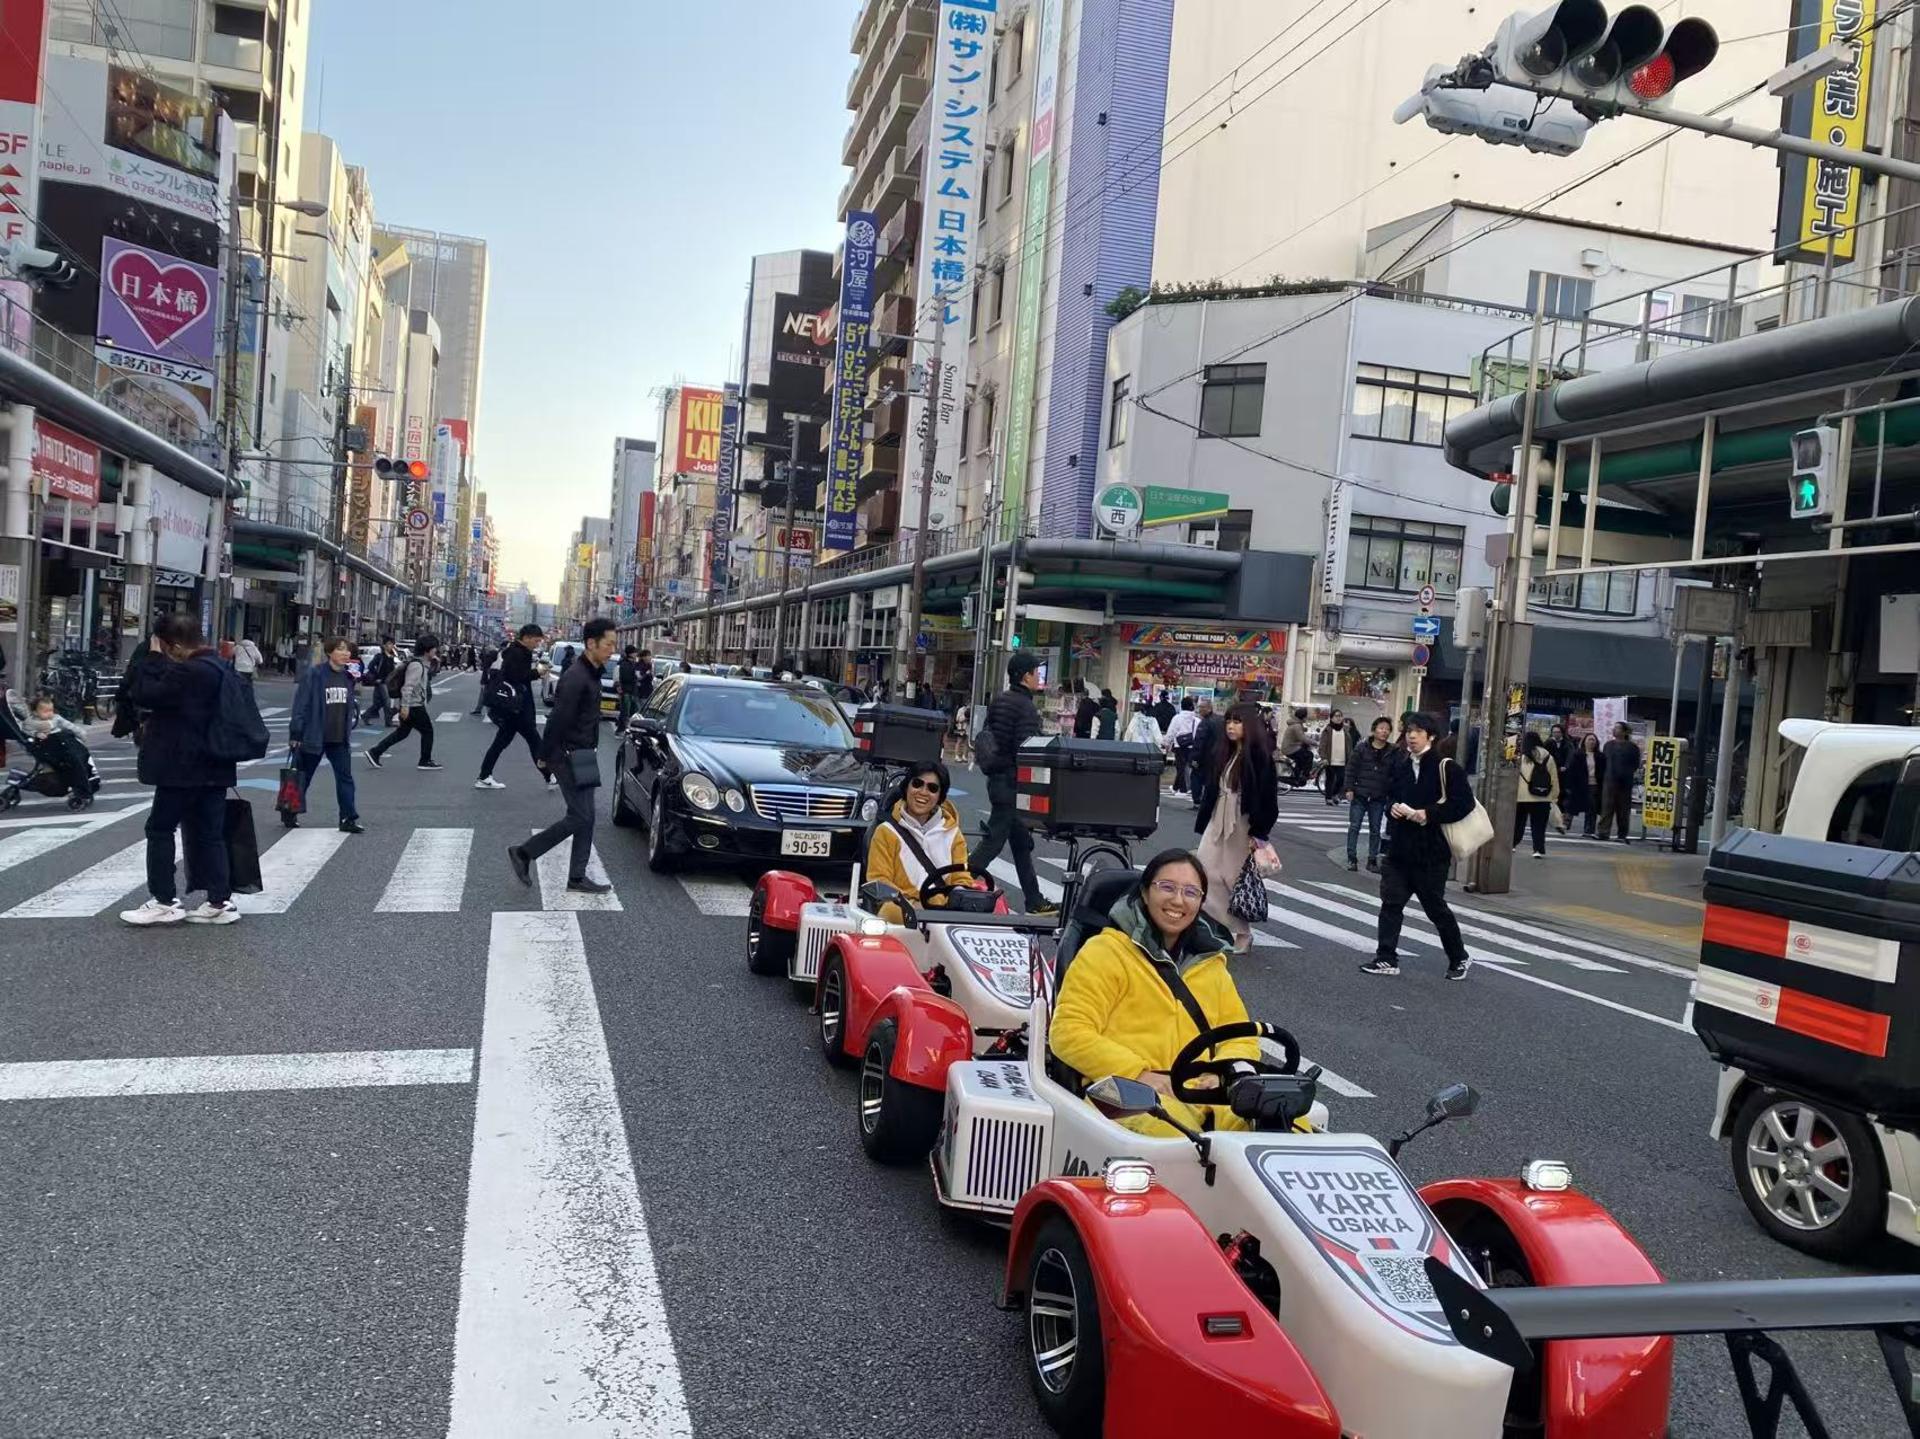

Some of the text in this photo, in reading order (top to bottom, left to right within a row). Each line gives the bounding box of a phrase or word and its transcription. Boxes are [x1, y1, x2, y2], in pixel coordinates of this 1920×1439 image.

[108, 172, 129, 187] TEL
[121, 272, 198, 316] 日本橋
[163, 363, 203, 382] ラーメン
[940, 363, 958, 424] Sound Bar
[717, 422, 736, 497] WINDOWS
[934, 470, 952, 484] Star
[1111, 508, 1126, 525] 西
[1324, 481, 1343, 593] Nature Maid
[154, 571, 190, 585] ラーメン
[1370, 562, 1457, 585] Nature
[1650, 740, 1676, 788] 防犯
[792, 841, 828, 854] 90-59
[961, 936, 1029, 948] FUTURE
[974, 946, 1024, 958] KART
[981, 956, 1029, 966] OSAKA
[1278, 1170, 1400, 1191] FUTURE
[1307, 1193, 1398, 1215] KART
[1328, 1217, 1415, 1233] OSAKA
